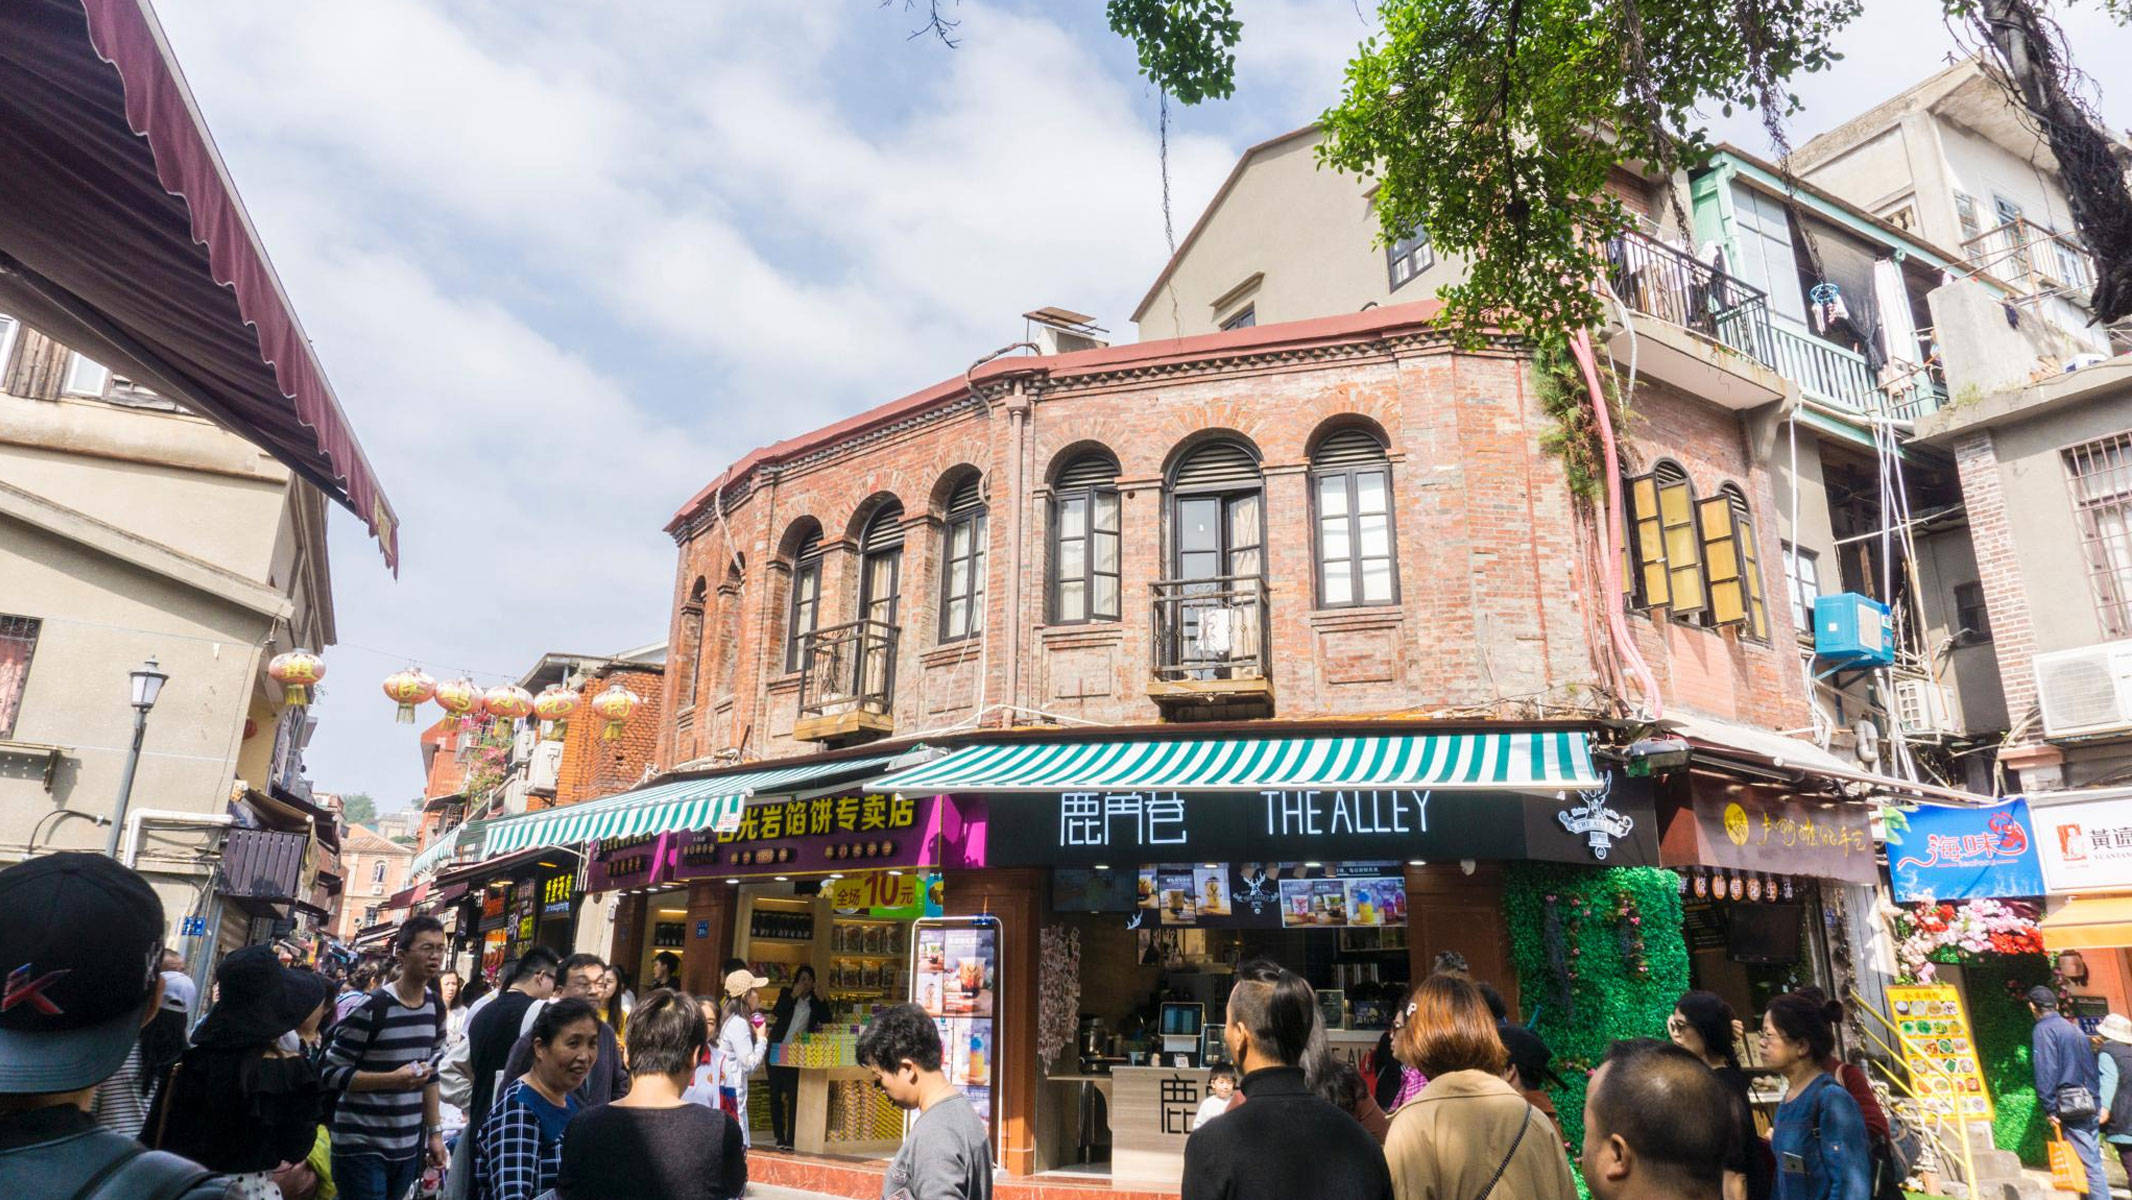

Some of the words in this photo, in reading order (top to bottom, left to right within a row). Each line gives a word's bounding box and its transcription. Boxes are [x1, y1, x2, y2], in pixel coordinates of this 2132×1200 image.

[1260, 790, 1323, 835] THE
[1330, 790, 1431, 834] ALLEY
[1925, 832, 2001, 861] 海味
